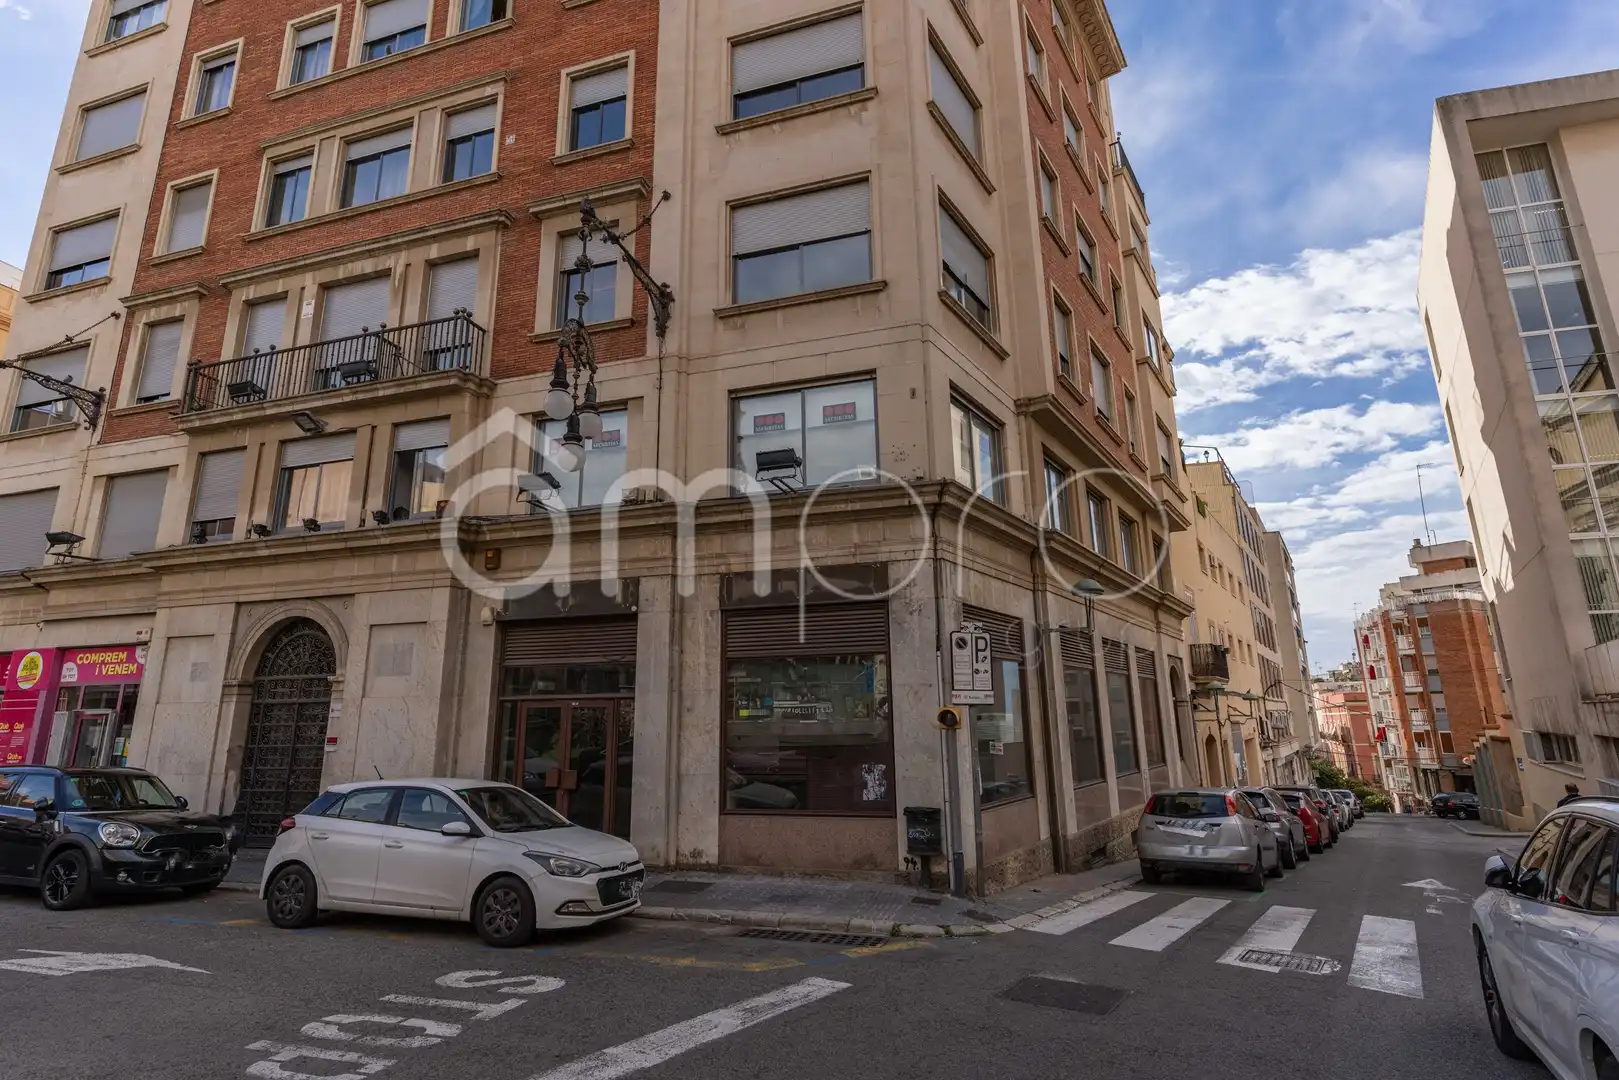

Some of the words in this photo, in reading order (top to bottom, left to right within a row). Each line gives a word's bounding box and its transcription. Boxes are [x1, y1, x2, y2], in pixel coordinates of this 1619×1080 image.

[76, 651, 128, 665] COMPREM
[975, 636, 988, 664] P
[101, 663, 138, 676] VENEM
[244, 969, 567, 1080] STOP
